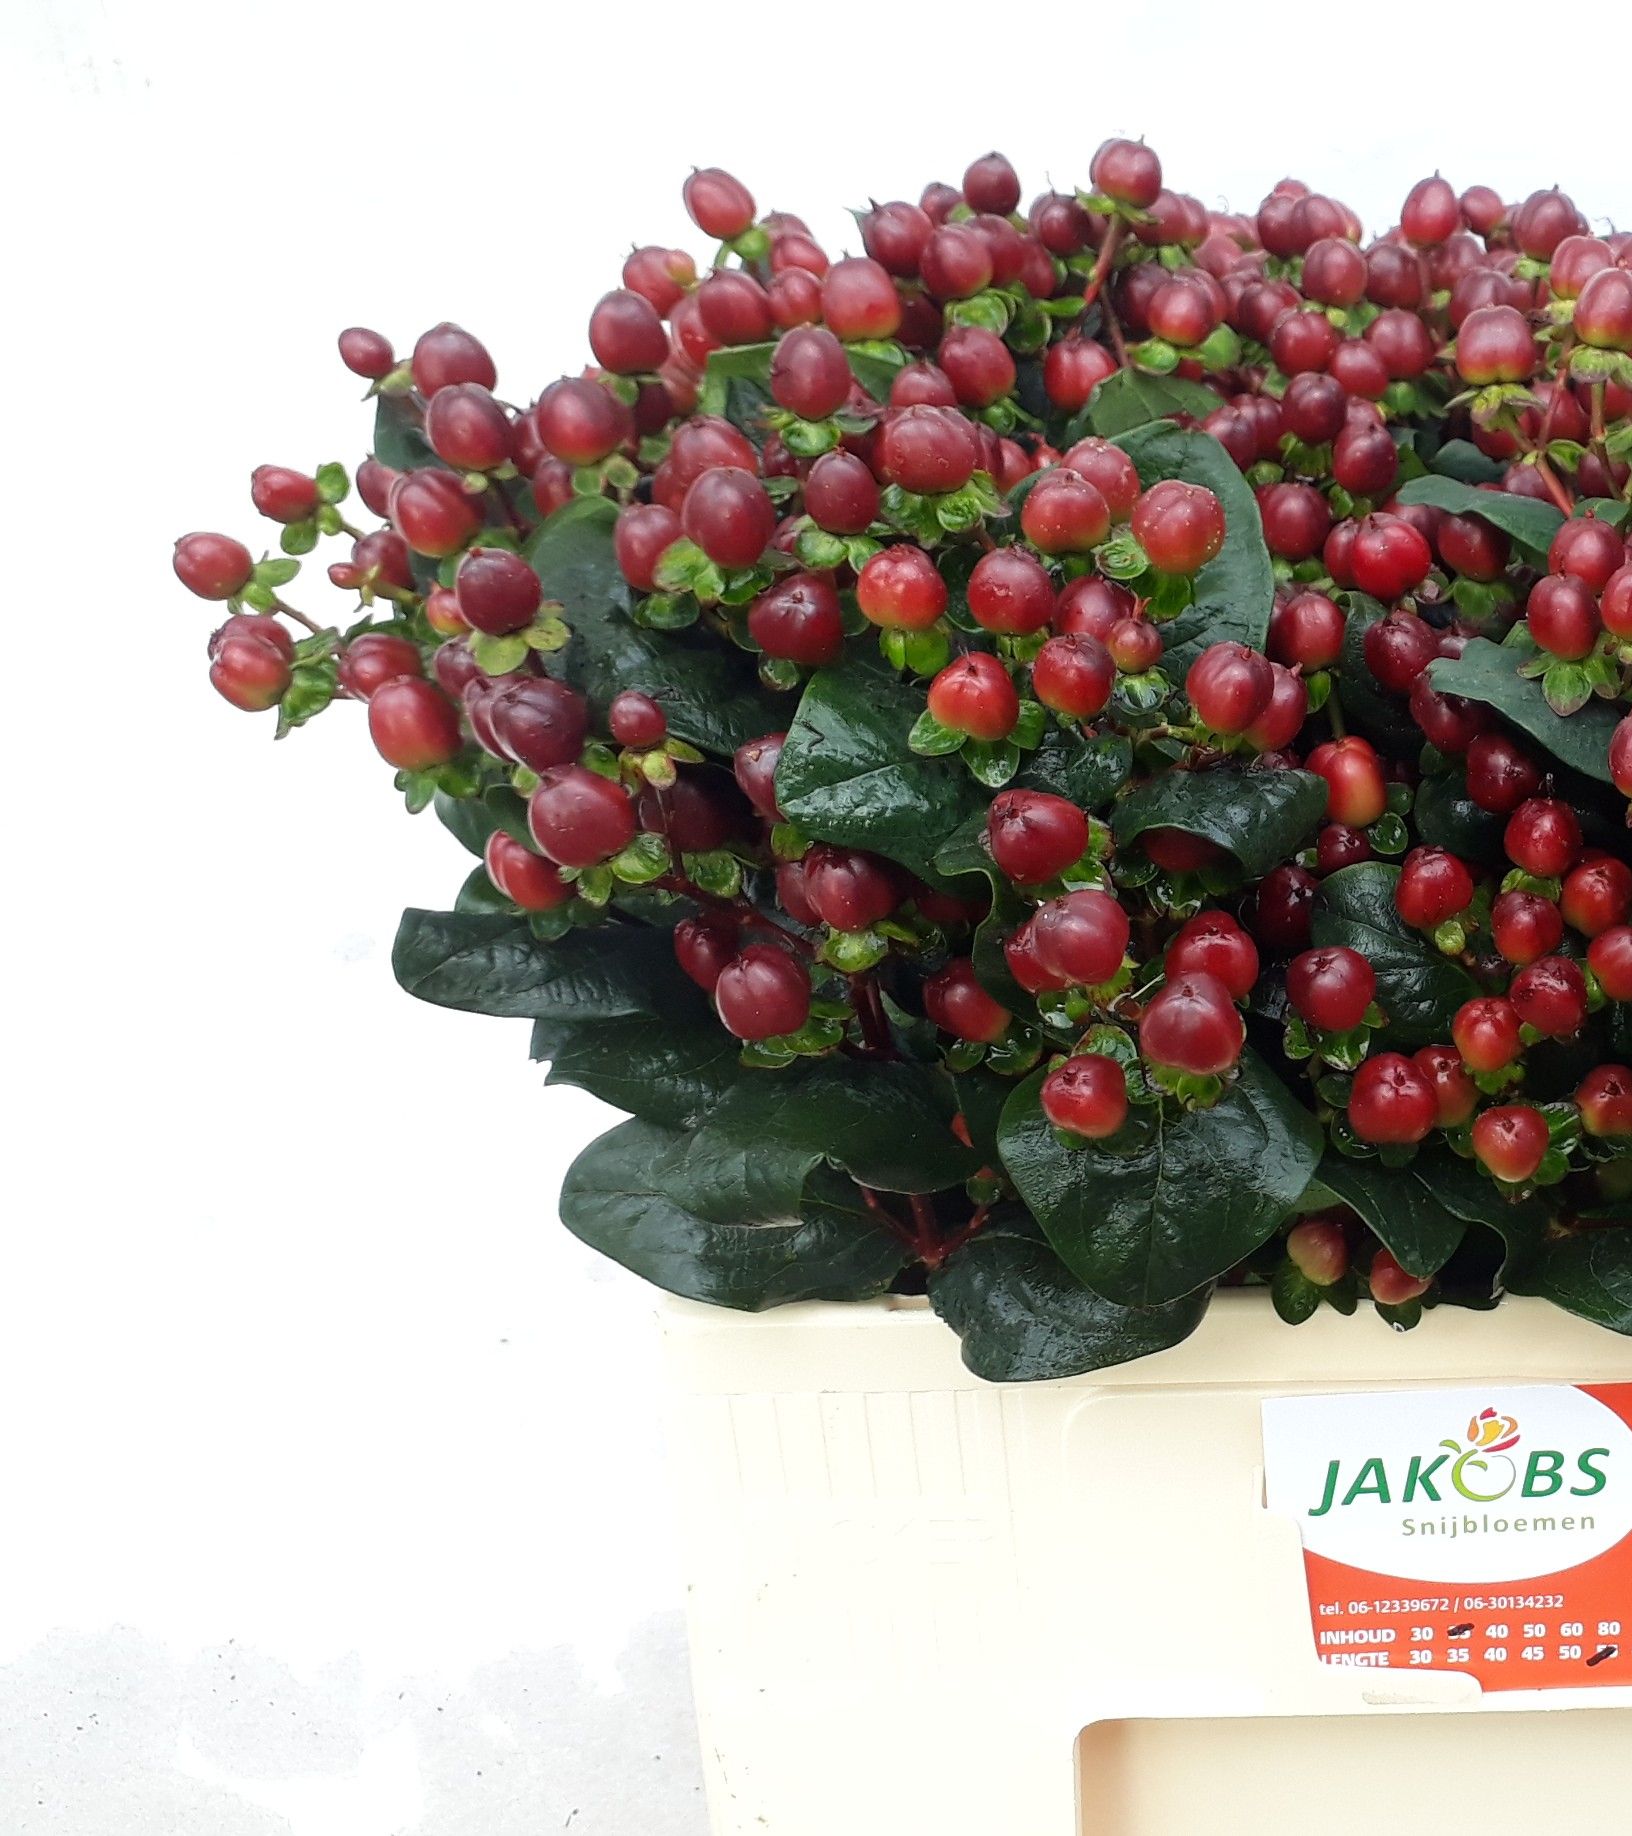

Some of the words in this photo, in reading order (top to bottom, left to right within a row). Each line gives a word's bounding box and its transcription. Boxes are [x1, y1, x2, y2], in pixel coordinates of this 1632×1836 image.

[1308, 1447, 1610, 1516] JAKOBS
[1402, 1514, 1595, 1538] Snijbloemen
[1318, 1601, 1344, 1616] tel.
[1347, 1598, 1450, 1615] 06-12339672
[1463, 1594, 1564, 1610] 06-30134232
[1318, 1628, 1397, 1645] INHOUD
[1410, 1626, 1434, 1642] 30
[1485, 1624, 1509, 1639] 40
[1523, 1623, 1547, 1639] 50
[1559, 1622, 1584, 1638] 60
[1597, 1621, 1621, 1637] 80
[1409, 1649, 1434, 1665] 30
[1446, 1647, 1470, 1664] 35
[1483, 1647, 1508, 1662] 40
[1520, 1646, 1545, 1661] 45
[1558, 1644, 1582, 1660] 50
